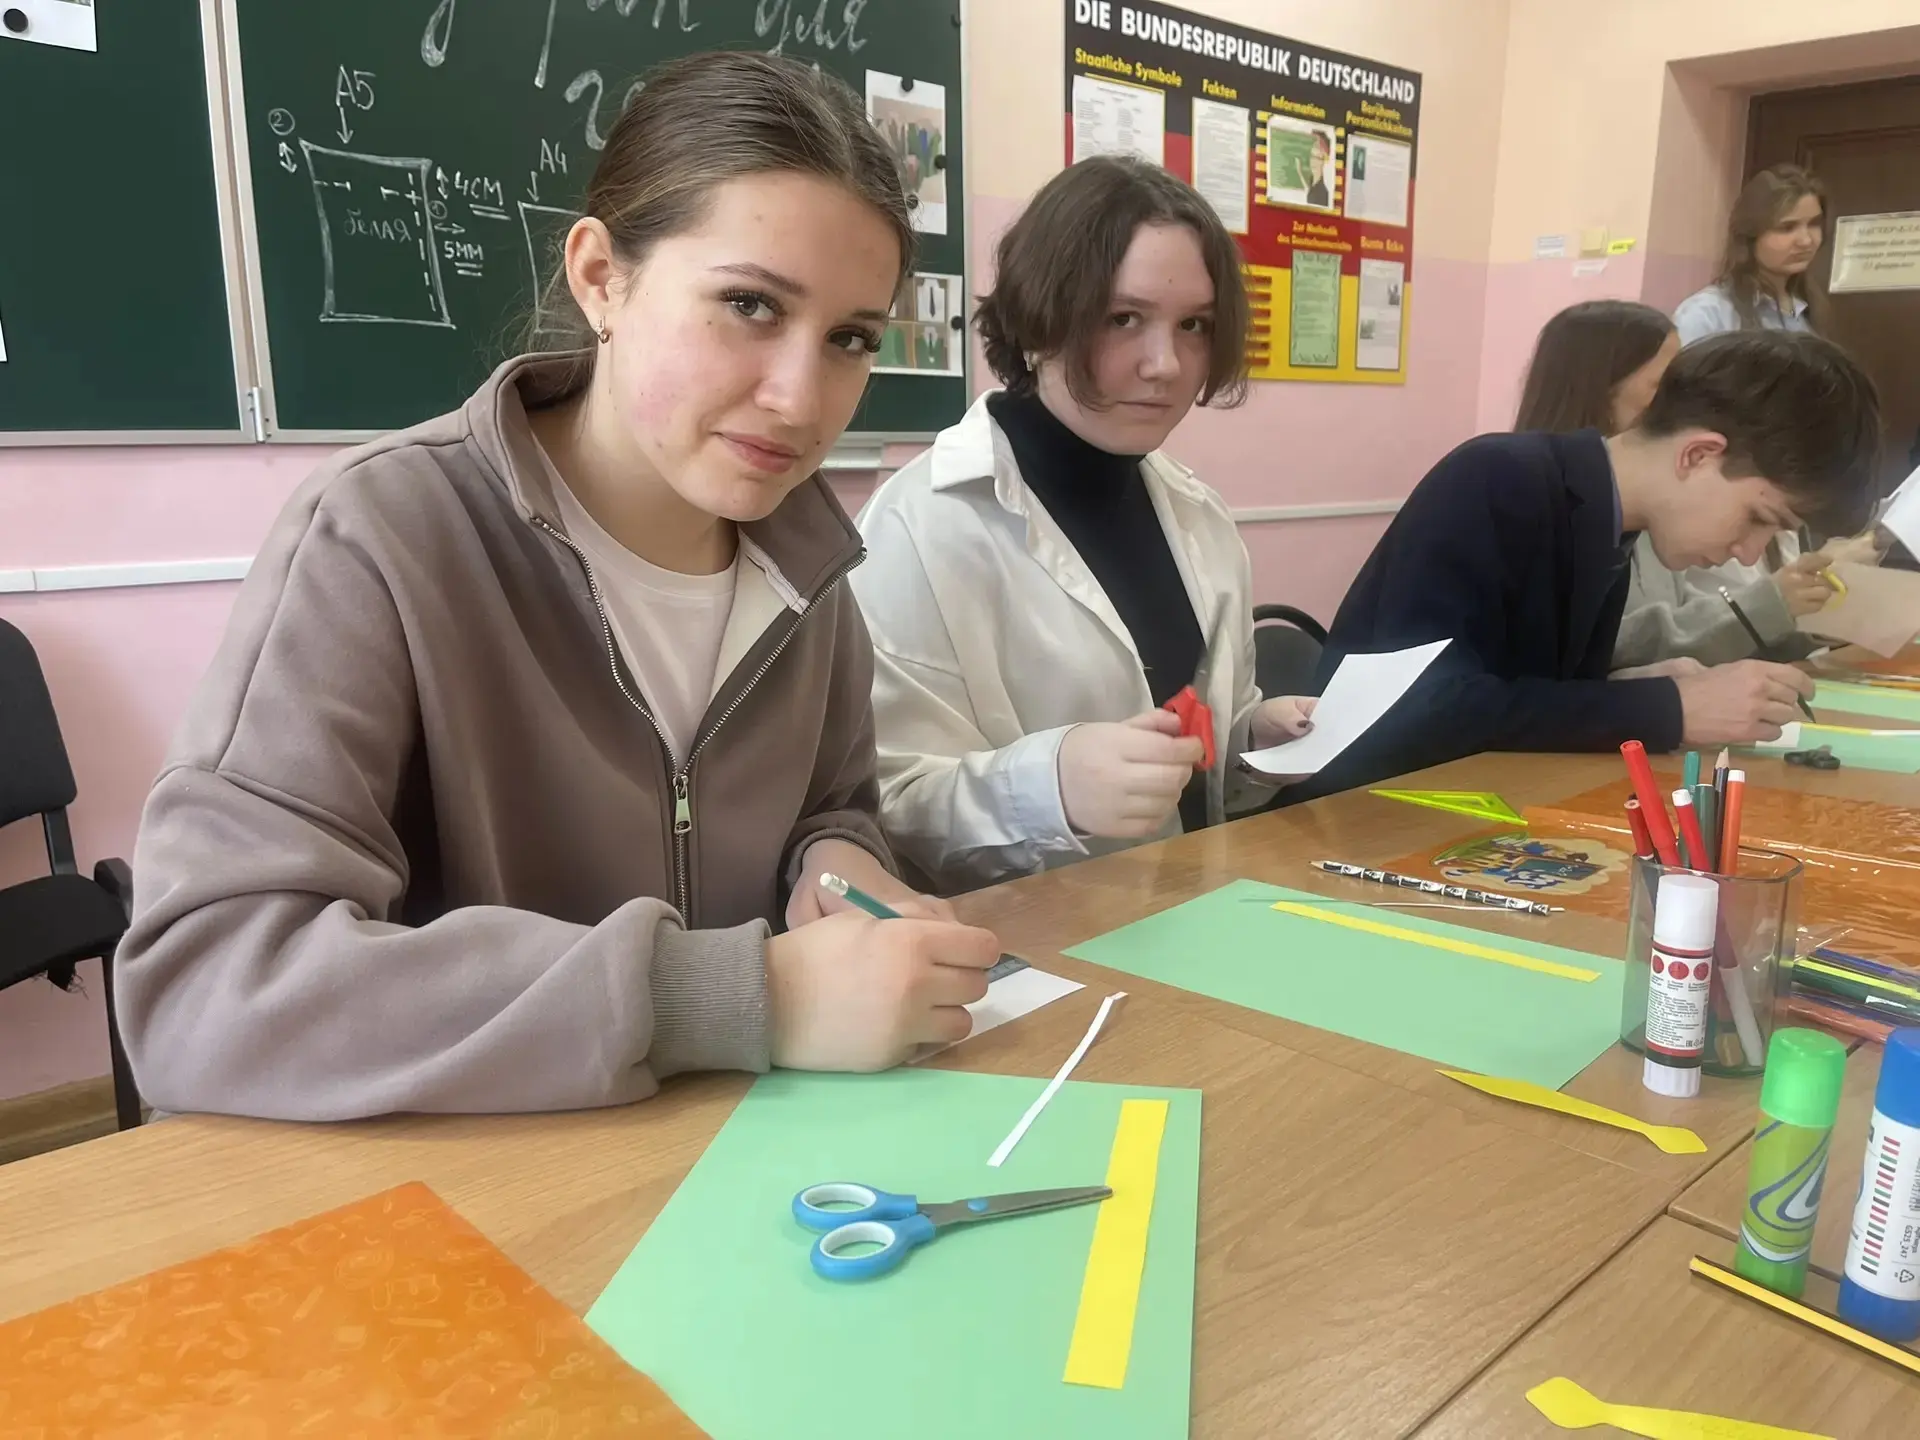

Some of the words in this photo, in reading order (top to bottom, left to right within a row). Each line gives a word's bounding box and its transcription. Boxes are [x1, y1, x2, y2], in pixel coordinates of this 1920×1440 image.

[1074, 0, 1112, 31] DIE
[1121, 6, 1292, 76] BUNDESREPUBLIK
[1299, 54, 1416, 105] DEUTSCHLAND
[1075, 47, 1133, 76] Staatliche
[1135, 62, 1183, 88] Symbole
[336, 63, 377, 111] A5
[1202, 78, 1238, 101] Fakten
[1271, 94, 1327, 120] Information
[540, 137, 569, 174] A4
